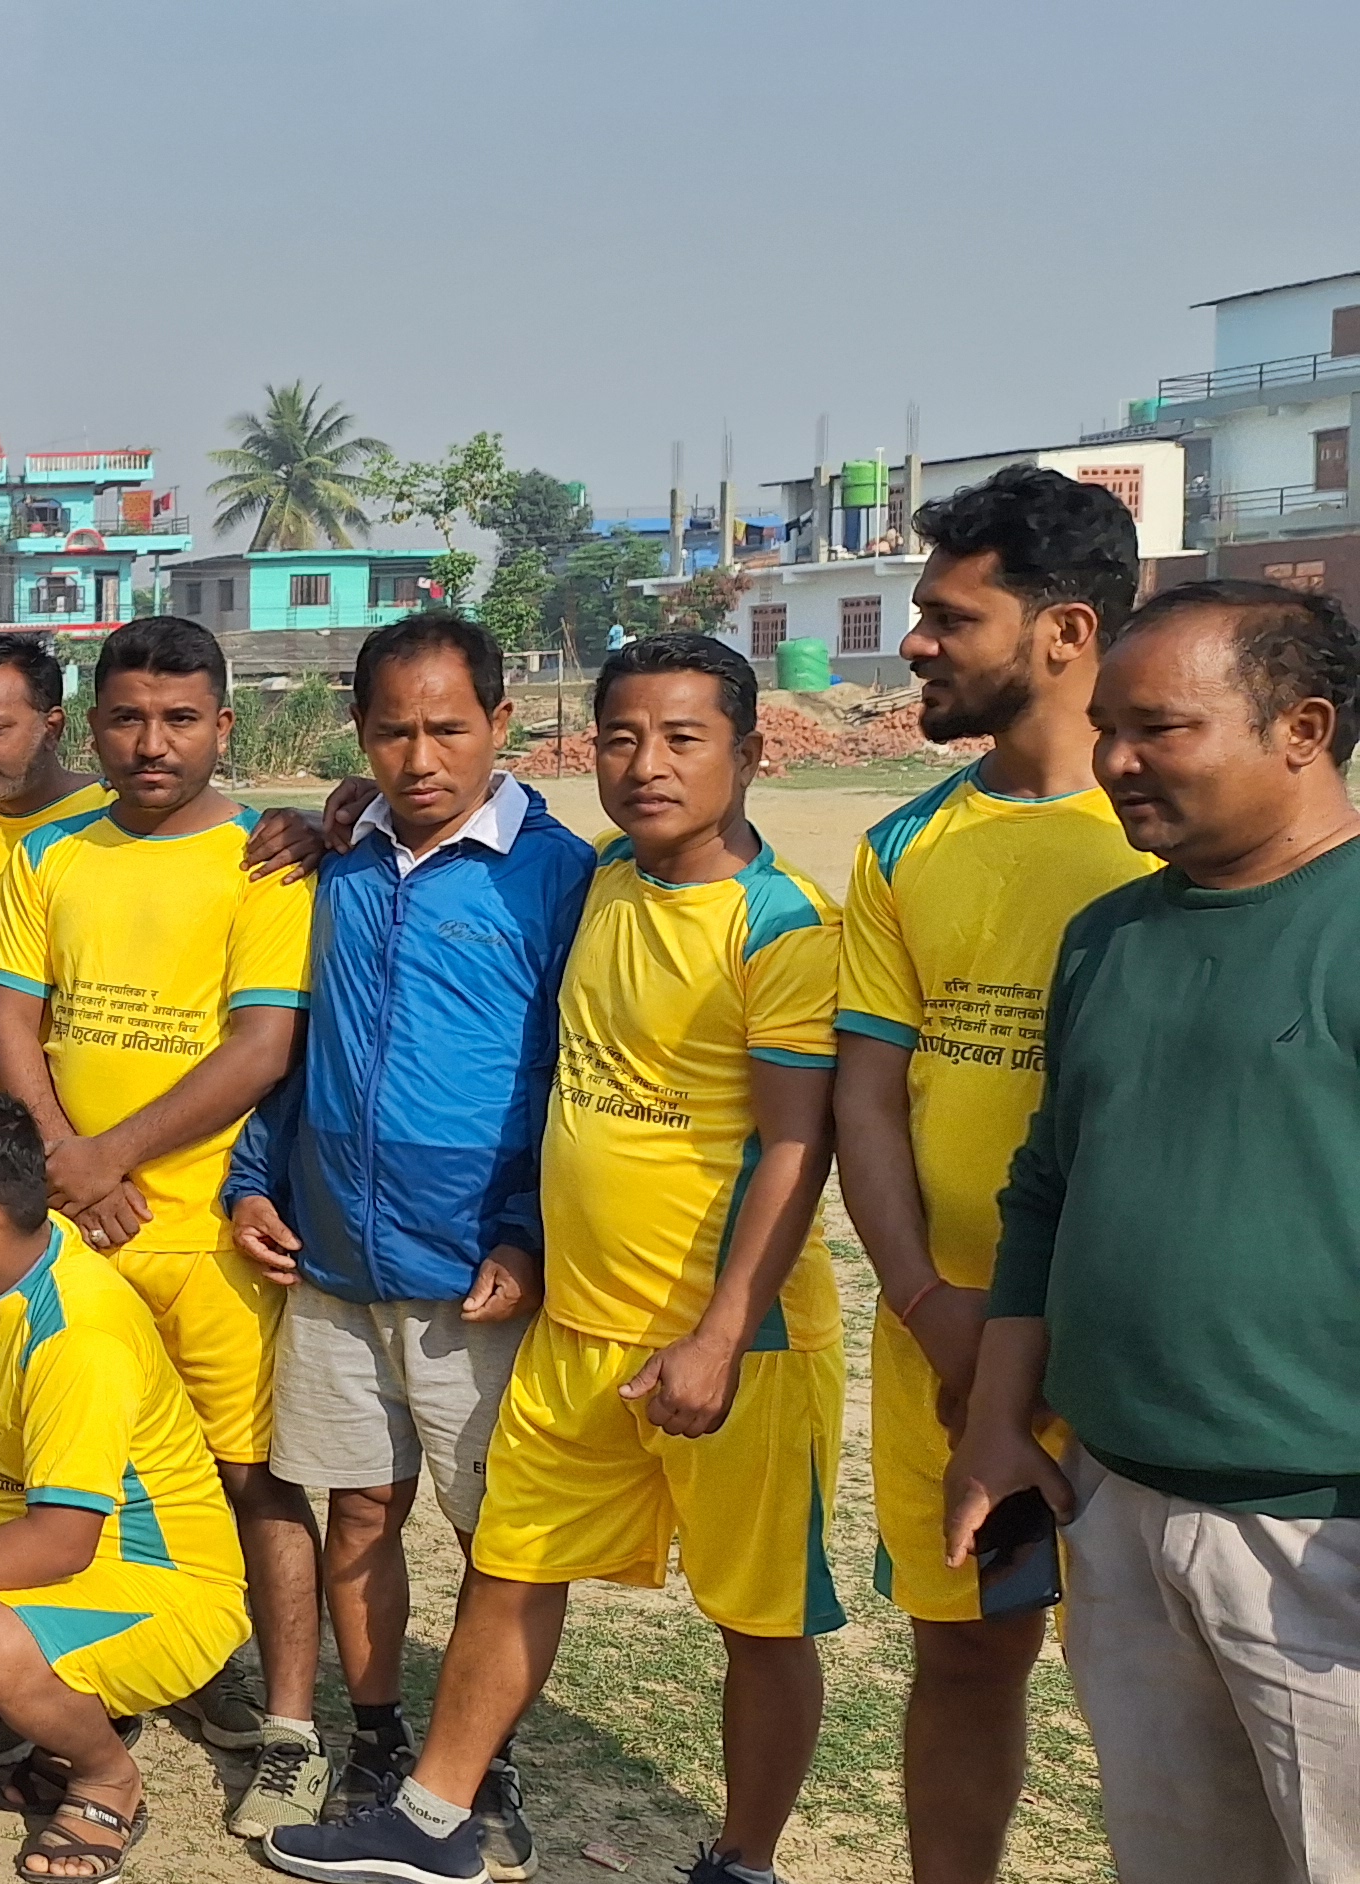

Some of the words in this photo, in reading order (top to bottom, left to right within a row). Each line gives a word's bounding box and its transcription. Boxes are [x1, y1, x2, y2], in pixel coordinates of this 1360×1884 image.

[72, 1024, 118, 1046] फुटबल
[121, 1030, 204, 1056] प्रतियोगिता
[595, 1094, 692, 1130] प्रतियोगिता
